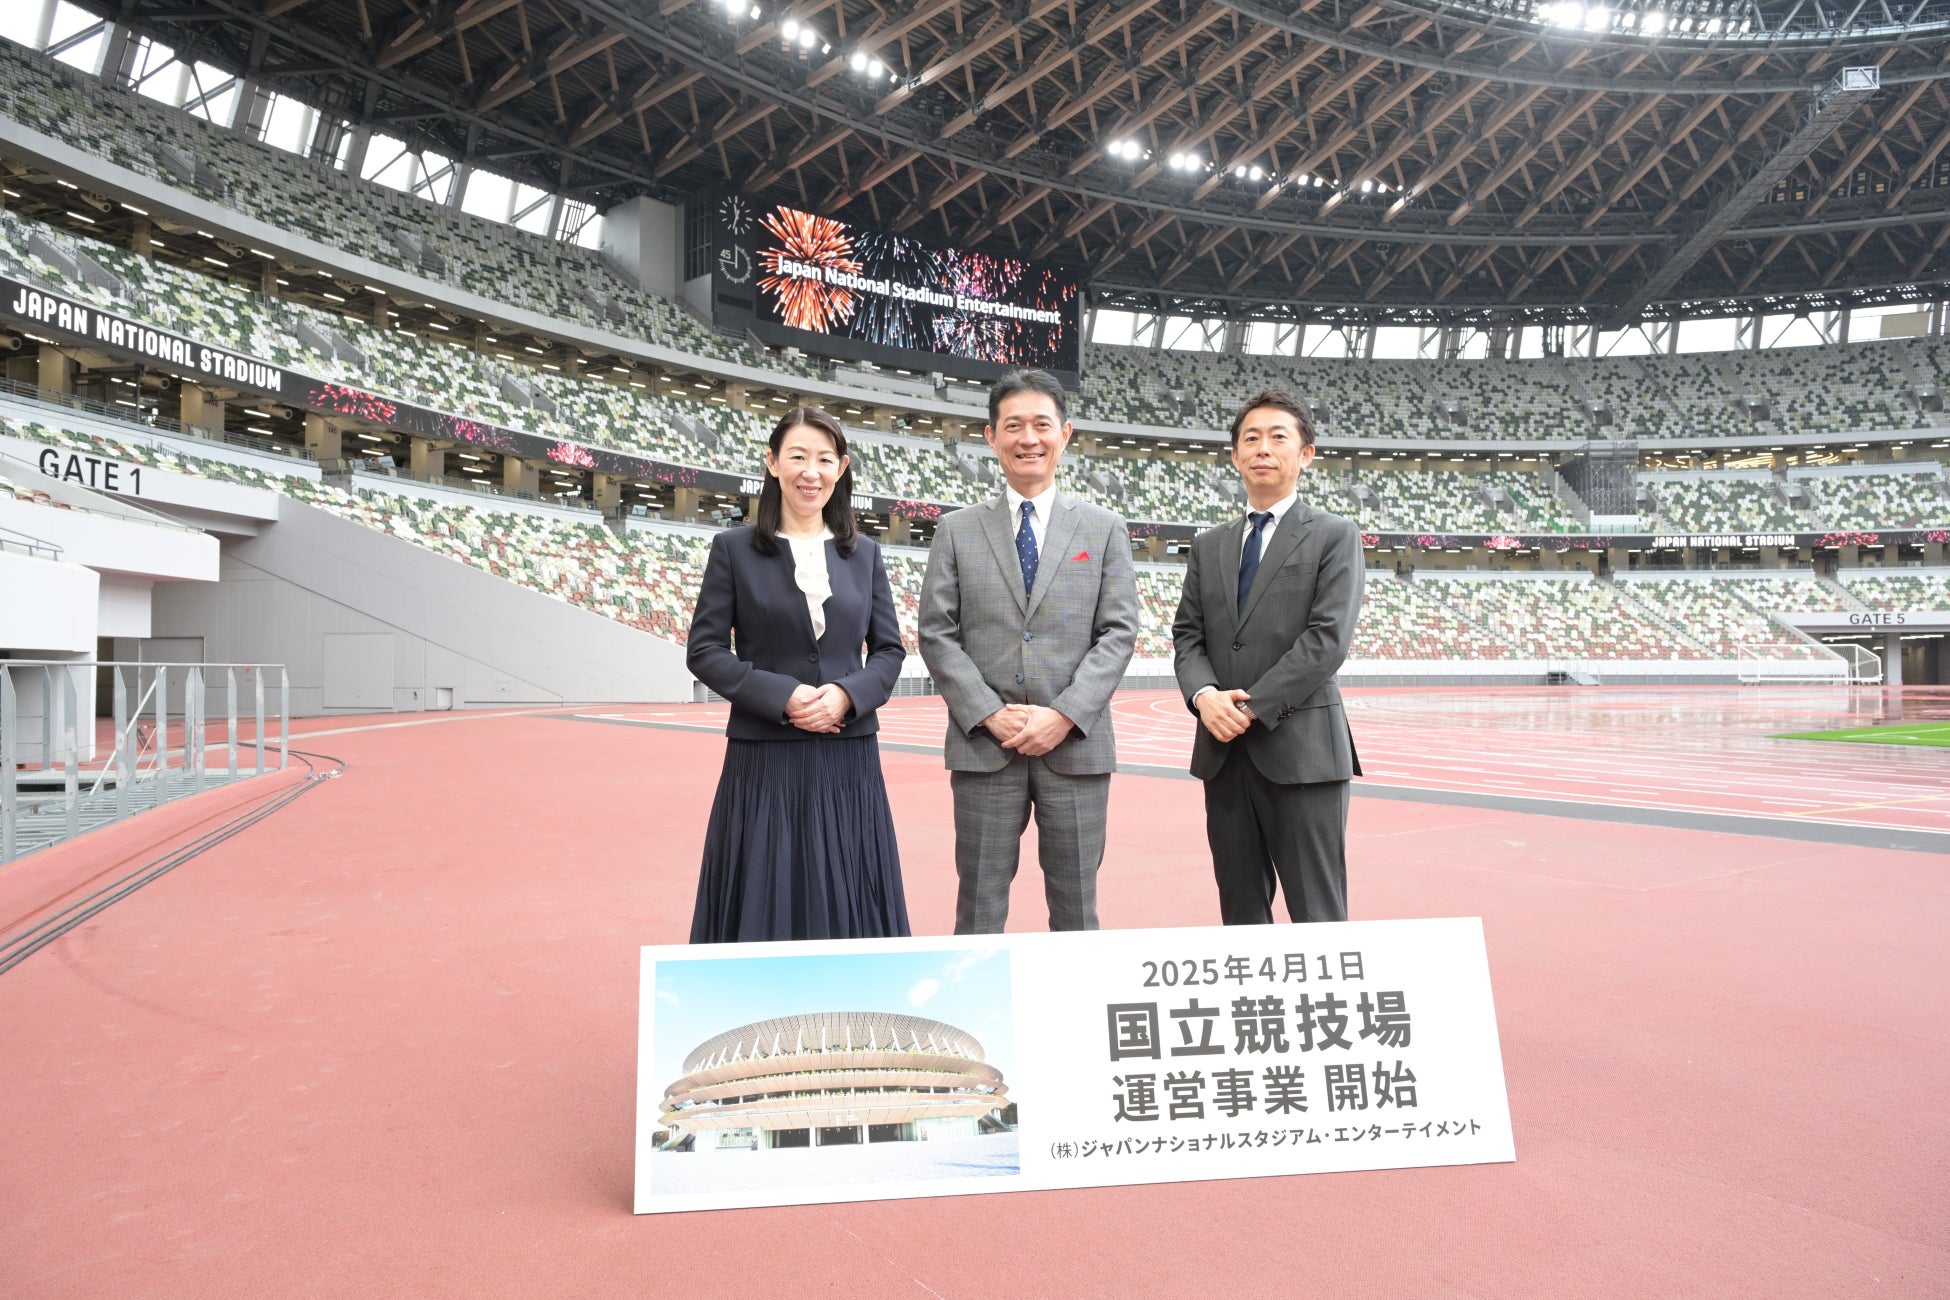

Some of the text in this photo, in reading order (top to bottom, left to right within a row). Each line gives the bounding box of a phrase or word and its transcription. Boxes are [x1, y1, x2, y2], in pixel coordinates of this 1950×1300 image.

[720, 249, 731, 259] 45
[776, 255, 1061, 324] Japan National Stadium Entertainment
[13, 288, 281, 392] JAPAN NATIONAL STADIUM
[39, 448, 140, 496] GATE 1
[740, 479, 765, 495] JAP
[1652, 535, 1795, 547] JAPAN NATIONAL STADIUM
[1849, 613, 1905, 625] GATE 5
[1143, 952, 1364, 987] 2025年4月1日
[1107, 991, 1410, 1061] 国立競技場
[1113, 1060, 1417, 1122] 運営事業 開始
